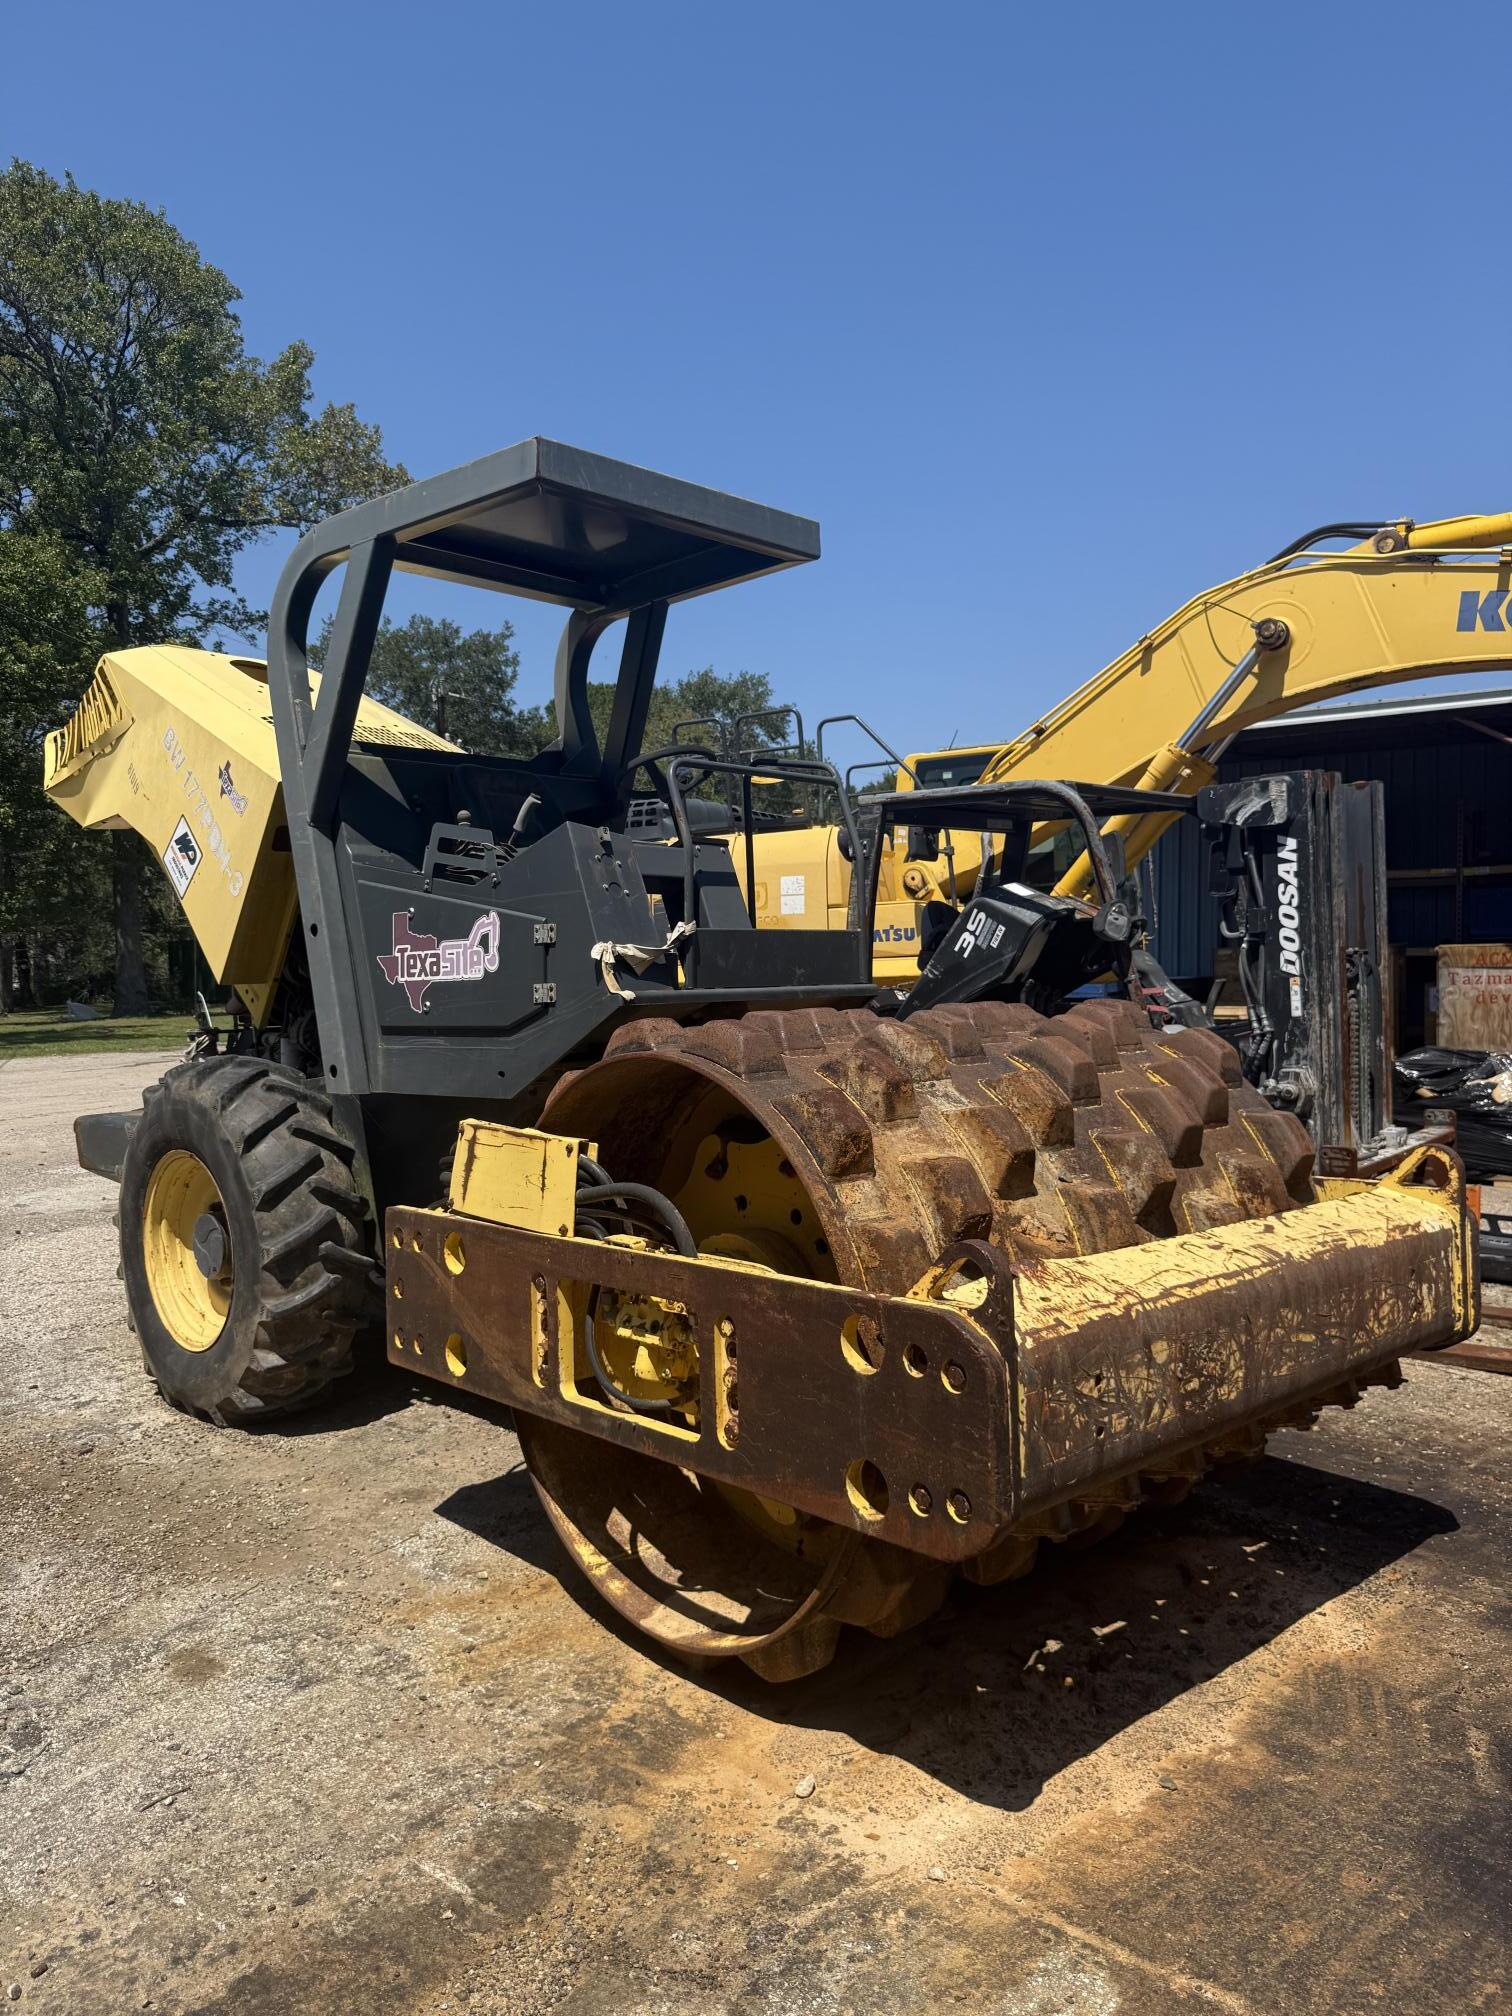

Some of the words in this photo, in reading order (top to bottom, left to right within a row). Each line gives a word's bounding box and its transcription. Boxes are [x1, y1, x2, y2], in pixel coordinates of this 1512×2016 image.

[1456, 591, 1512, 632] K
[1277, 835, 1299, 976] DOOSAN
[953, 908, 987, 959] 35
